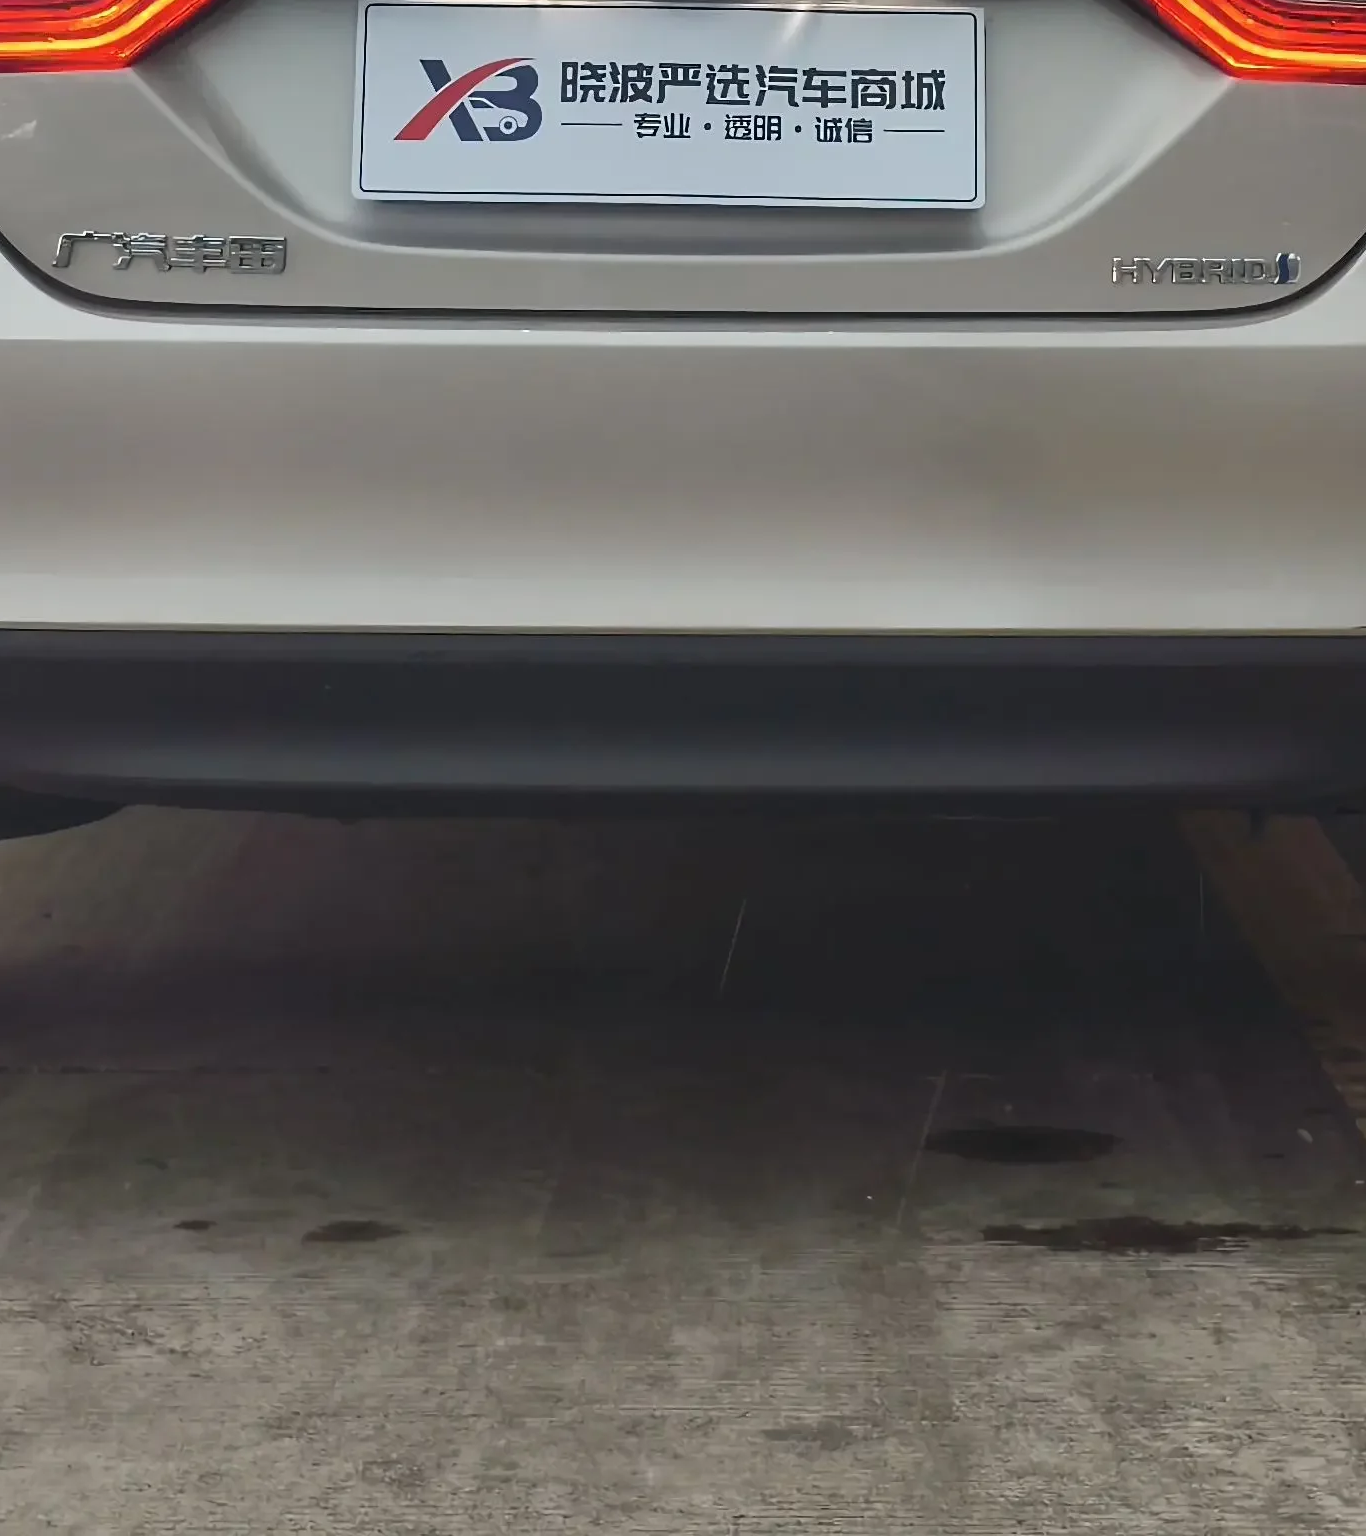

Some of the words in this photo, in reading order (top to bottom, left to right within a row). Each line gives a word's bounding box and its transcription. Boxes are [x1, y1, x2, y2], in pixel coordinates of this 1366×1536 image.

[560, 61, 946, 111] 晓波严选汽车商城
[51, 230, 287, 274] 广汽丰田
[1111, 256, 1270, 285] HYBRID
